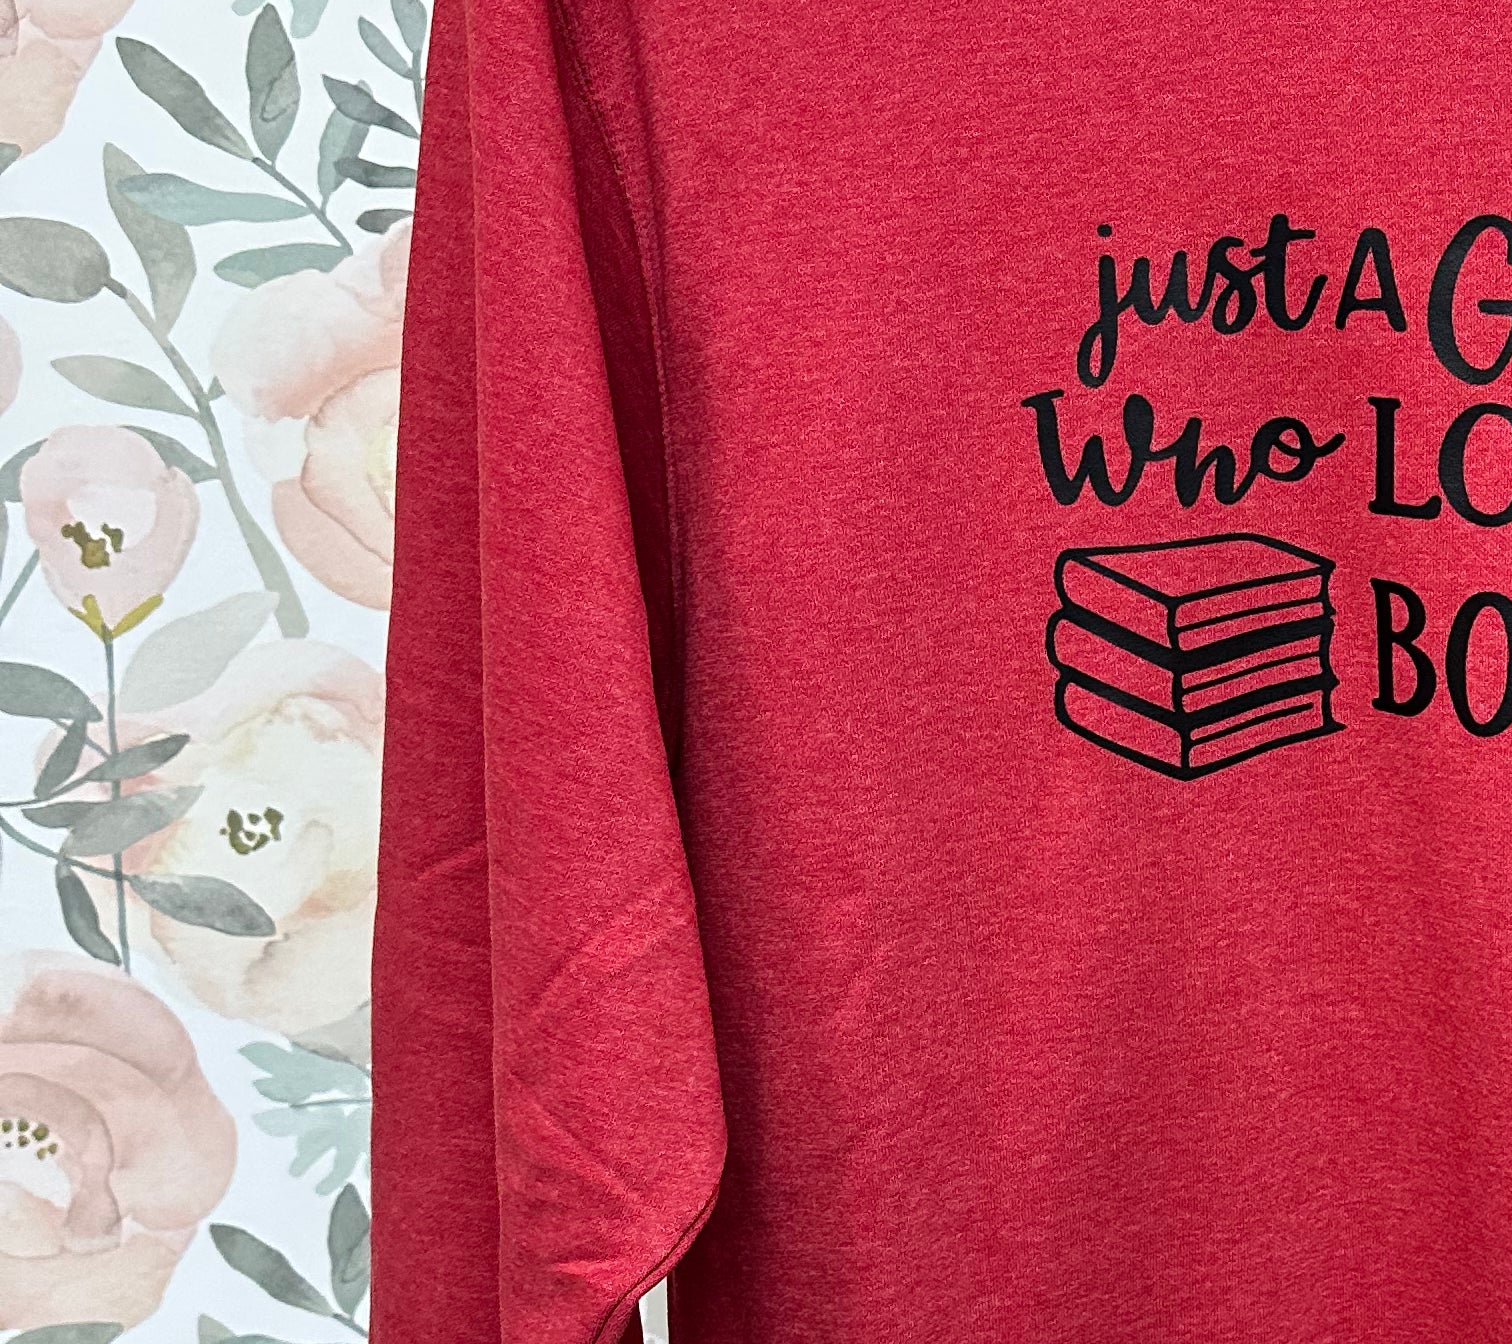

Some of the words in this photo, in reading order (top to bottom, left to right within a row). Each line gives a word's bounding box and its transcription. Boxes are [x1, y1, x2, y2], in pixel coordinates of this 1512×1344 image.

[1077, 213, 1329, 388] just
[1335, 227, 1407, 332] A
[1021, 388, 1346, 507] Who
